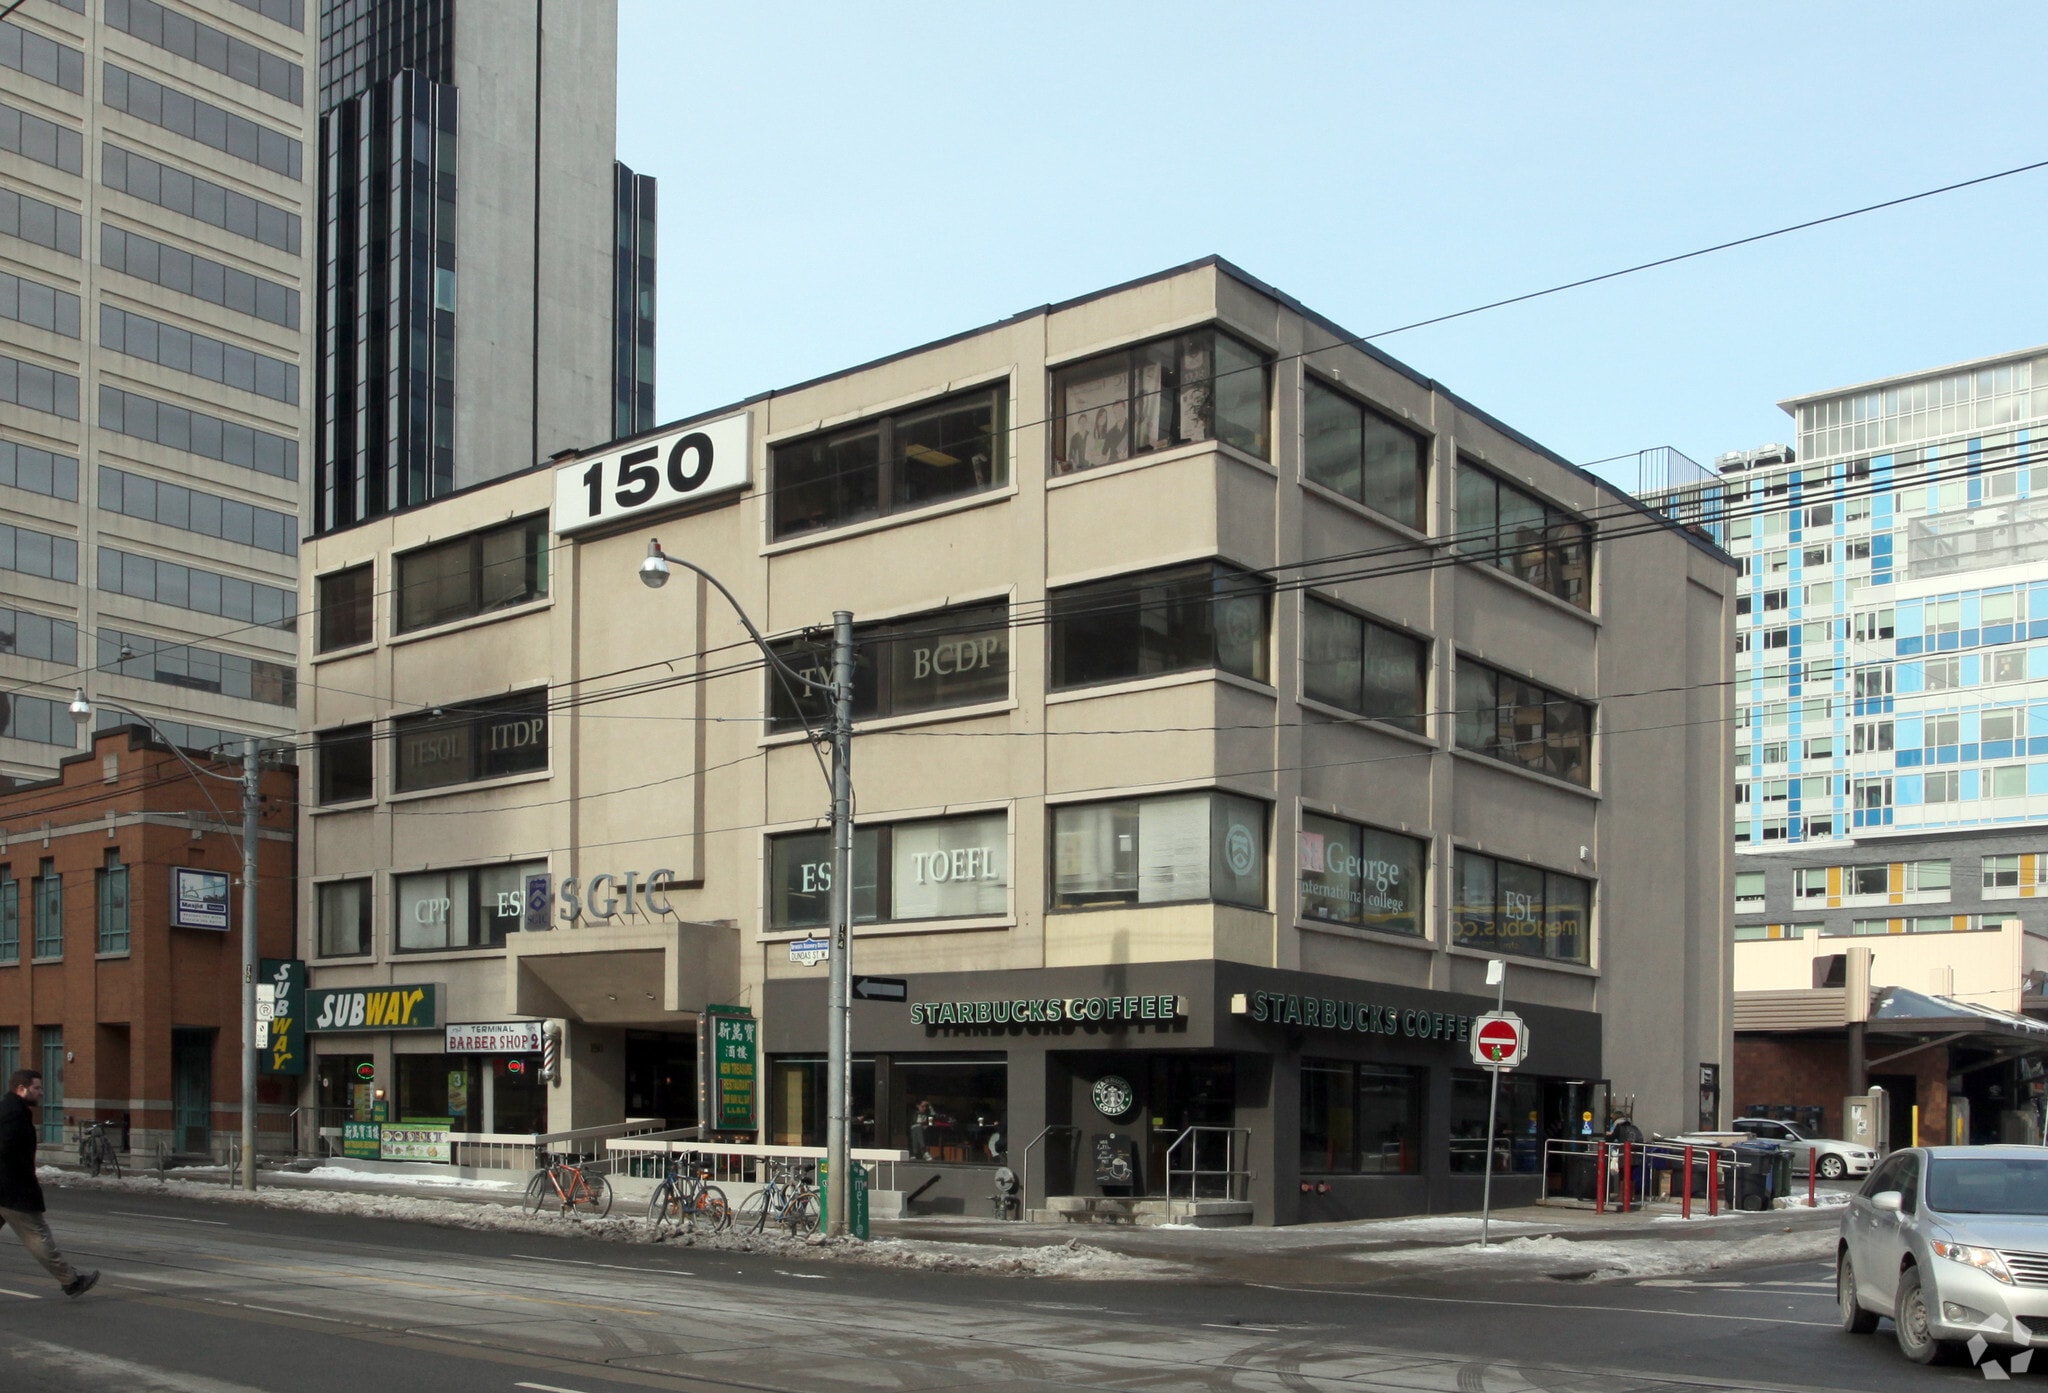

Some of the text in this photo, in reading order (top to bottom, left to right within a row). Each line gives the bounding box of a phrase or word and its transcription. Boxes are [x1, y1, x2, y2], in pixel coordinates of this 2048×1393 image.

[583, 432, 714, 517] 150
[914, 635, 998, 679] BCDP
[410, 734, 460, 765] TESOL
[491, 718, 544, 751] ITDP
[801, 861, 832, 893] ES
[911, 846, 998, 884] TOEFL
[1326, 842, 1400, 892] George
[415, 897, 450, 923] CPP
[560, 868, 675, 921] SGIC
[1301, 880, 1404, 915] nternational college
[1505, 890, 1536, 922] ESL
[791, 951, 811, 960] DUNDAS
[272, 963, 293, 1070] SUBWAY
[316, 987, 424, 1029] SUBWAY
[910, 995, 1174, 1024] STARBUCKS COFFEE
[1252, 989, 1398, 1035] STARBUCKS
[449, 1033, 539, 1050] BARBER SHOP 2
[471, 1025, 514, 1033] TERMINAL
[1099, 1103, 1126, 1114] COFFEE
